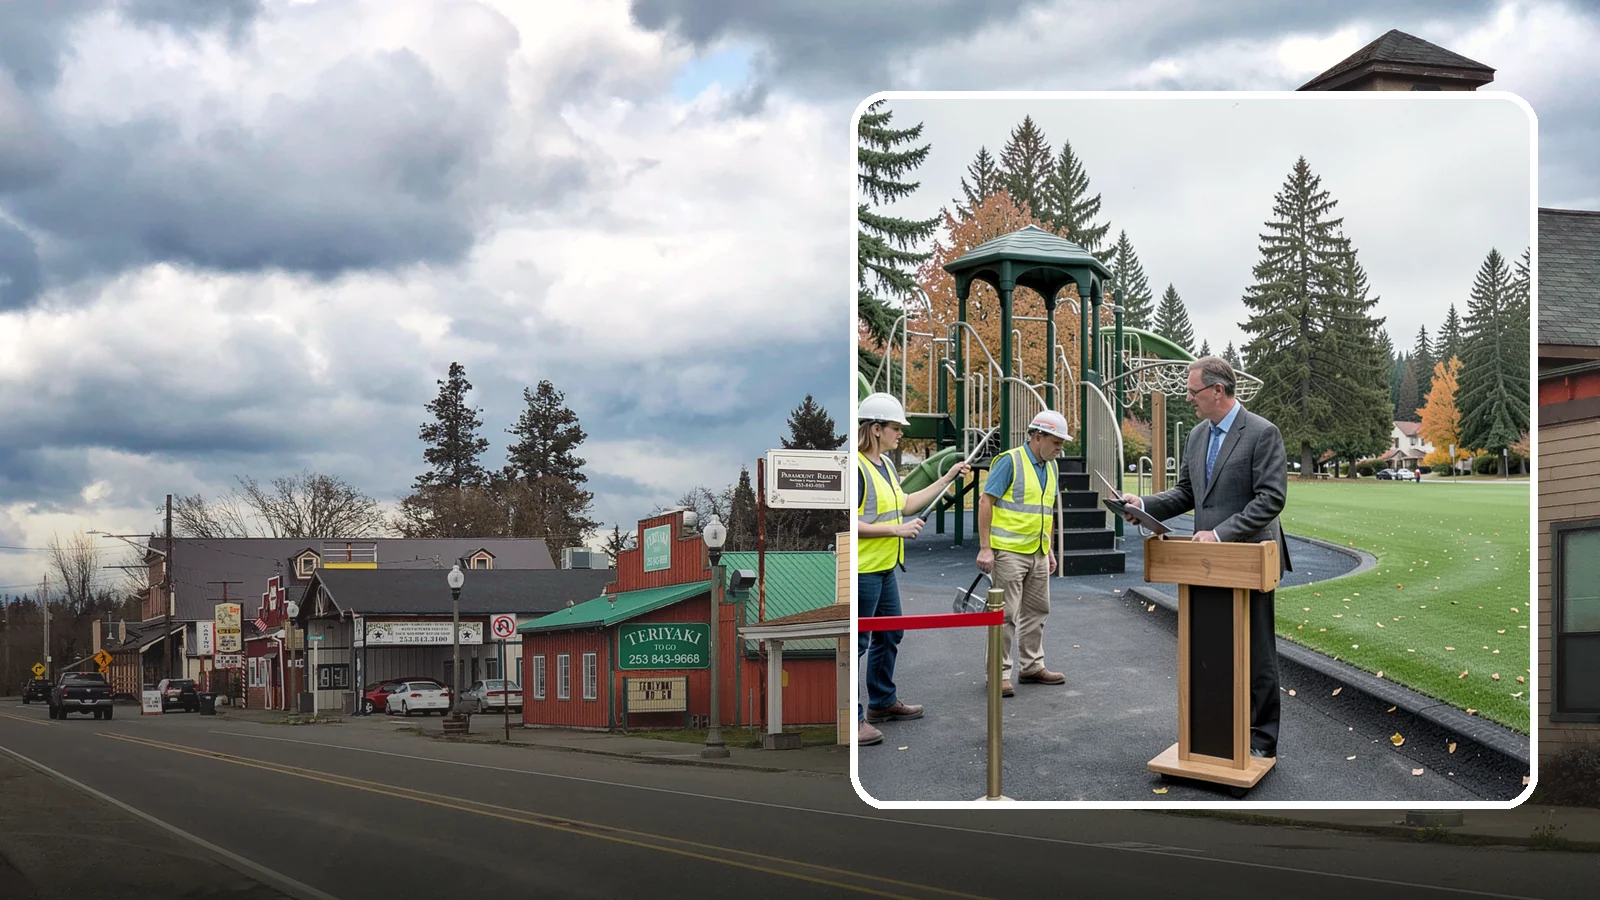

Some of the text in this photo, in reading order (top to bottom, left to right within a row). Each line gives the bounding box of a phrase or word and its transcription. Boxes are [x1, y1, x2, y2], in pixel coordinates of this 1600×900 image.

[781, 471, 839, 480] PARAMOUNT REALTY
[624, 627, 702, 646] TERIYAKI
[653, 643, 677, 651] TO GO
[628, 653, 700, 665] 253 843-9668
[639, 681, 673, 691] TERIYAKI
